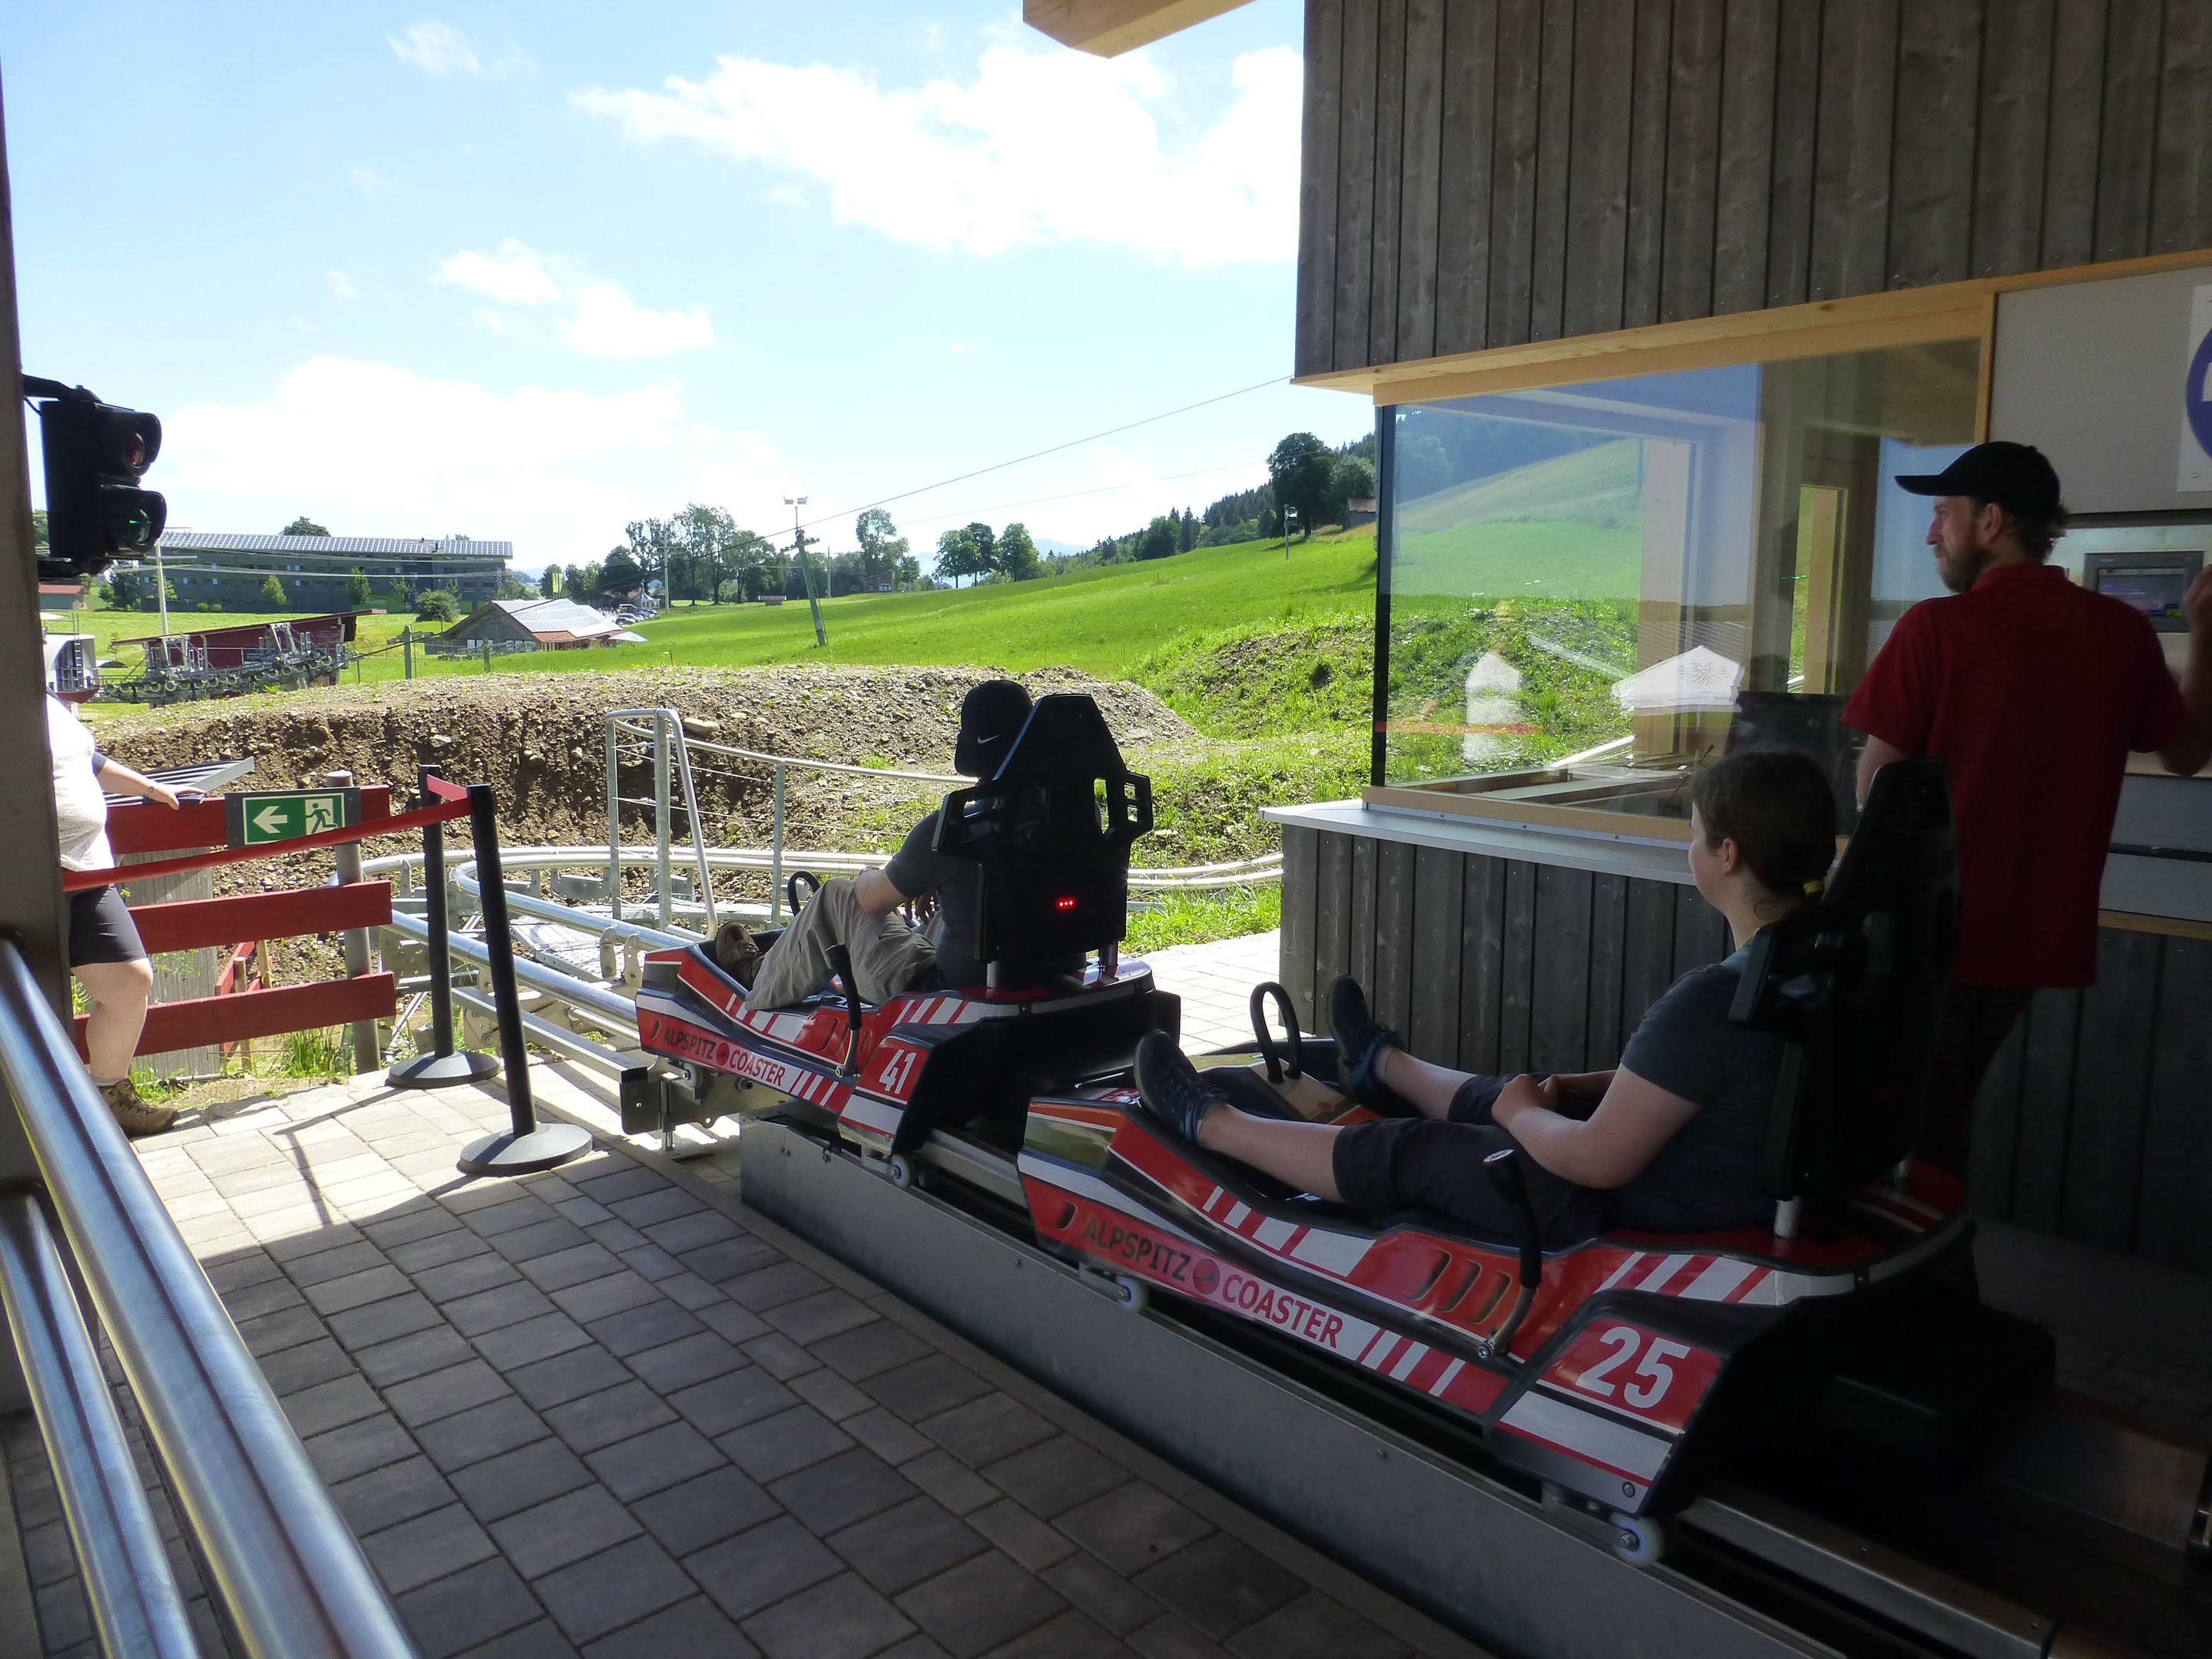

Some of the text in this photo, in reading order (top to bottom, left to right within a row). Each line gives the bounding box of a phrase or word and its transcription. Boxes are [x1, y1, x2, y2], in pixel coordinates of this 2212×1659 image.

[664, 1027, 786, 1086] ALPSPITZ COASTER
[879, 1049, 917, 1094] 41
[1082, 1217, 1343, 1348] ALPSPITZ COASTER
[1575, 1326, 1690, 1409] 25
